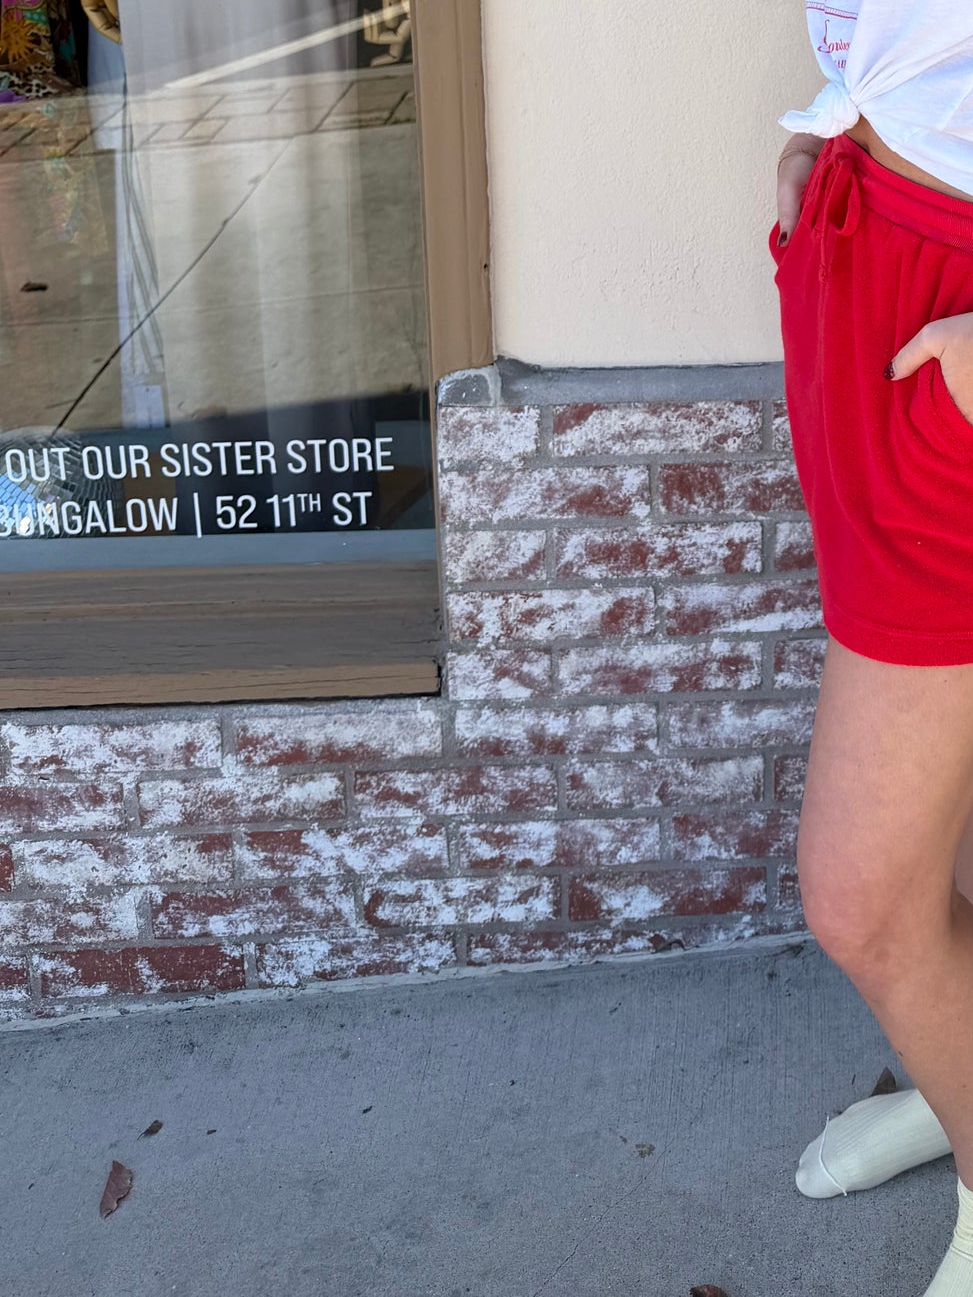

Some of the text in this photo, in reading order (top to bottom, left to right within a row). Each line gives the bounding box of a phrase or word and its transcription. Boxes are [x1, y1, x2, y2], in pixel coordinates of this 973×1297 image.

[5, 437, 394, 482] OUT OUR SISTER STORE
[216, 494, 258, 529] 52
[266, 493, 321, 528] 11TH
[332, 491, 372, 526] ST
